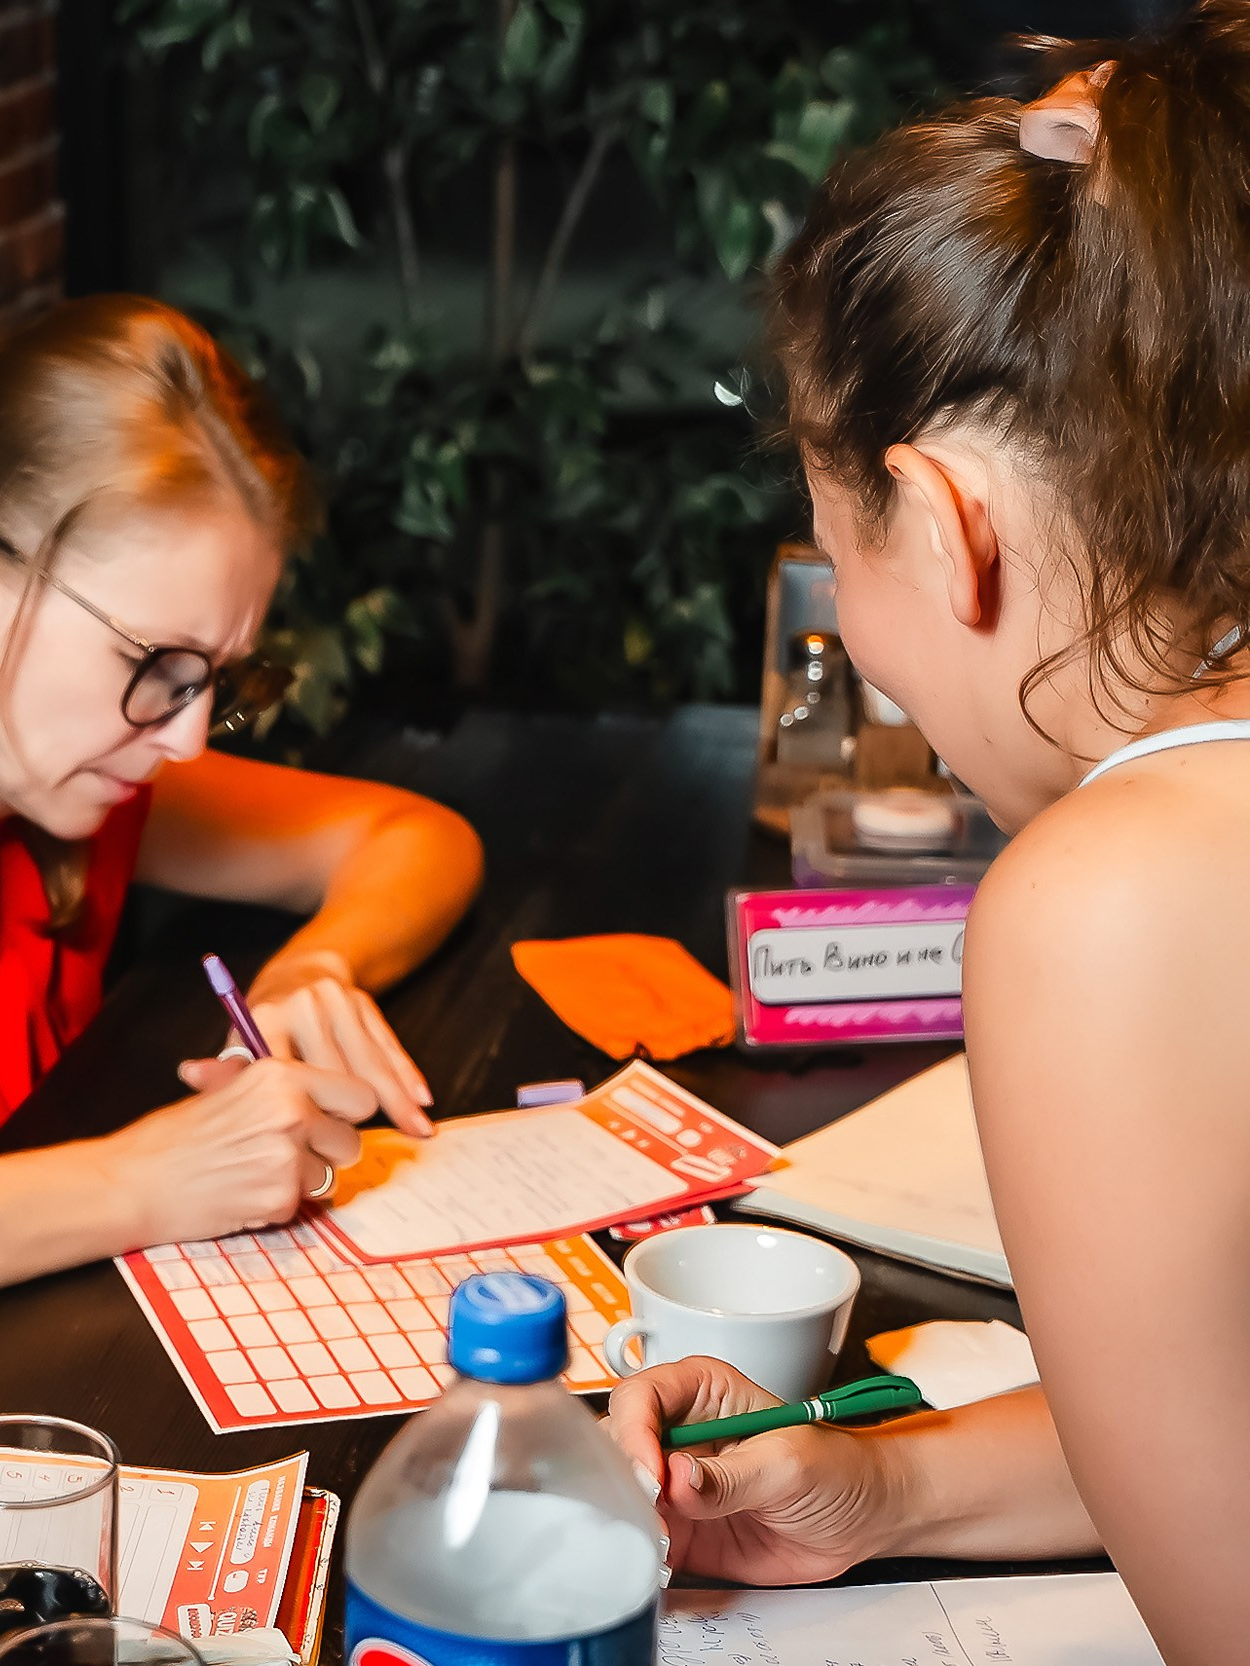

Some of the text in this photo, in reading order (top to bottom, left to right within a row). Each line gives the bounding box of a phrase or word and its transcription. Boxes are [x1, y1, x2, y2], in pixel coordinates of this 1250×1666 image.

[753, 943, 812, 980] Пить
[823, 941, 888, 970] Вино
[215, 1611, 237, 1636] QUIZ
